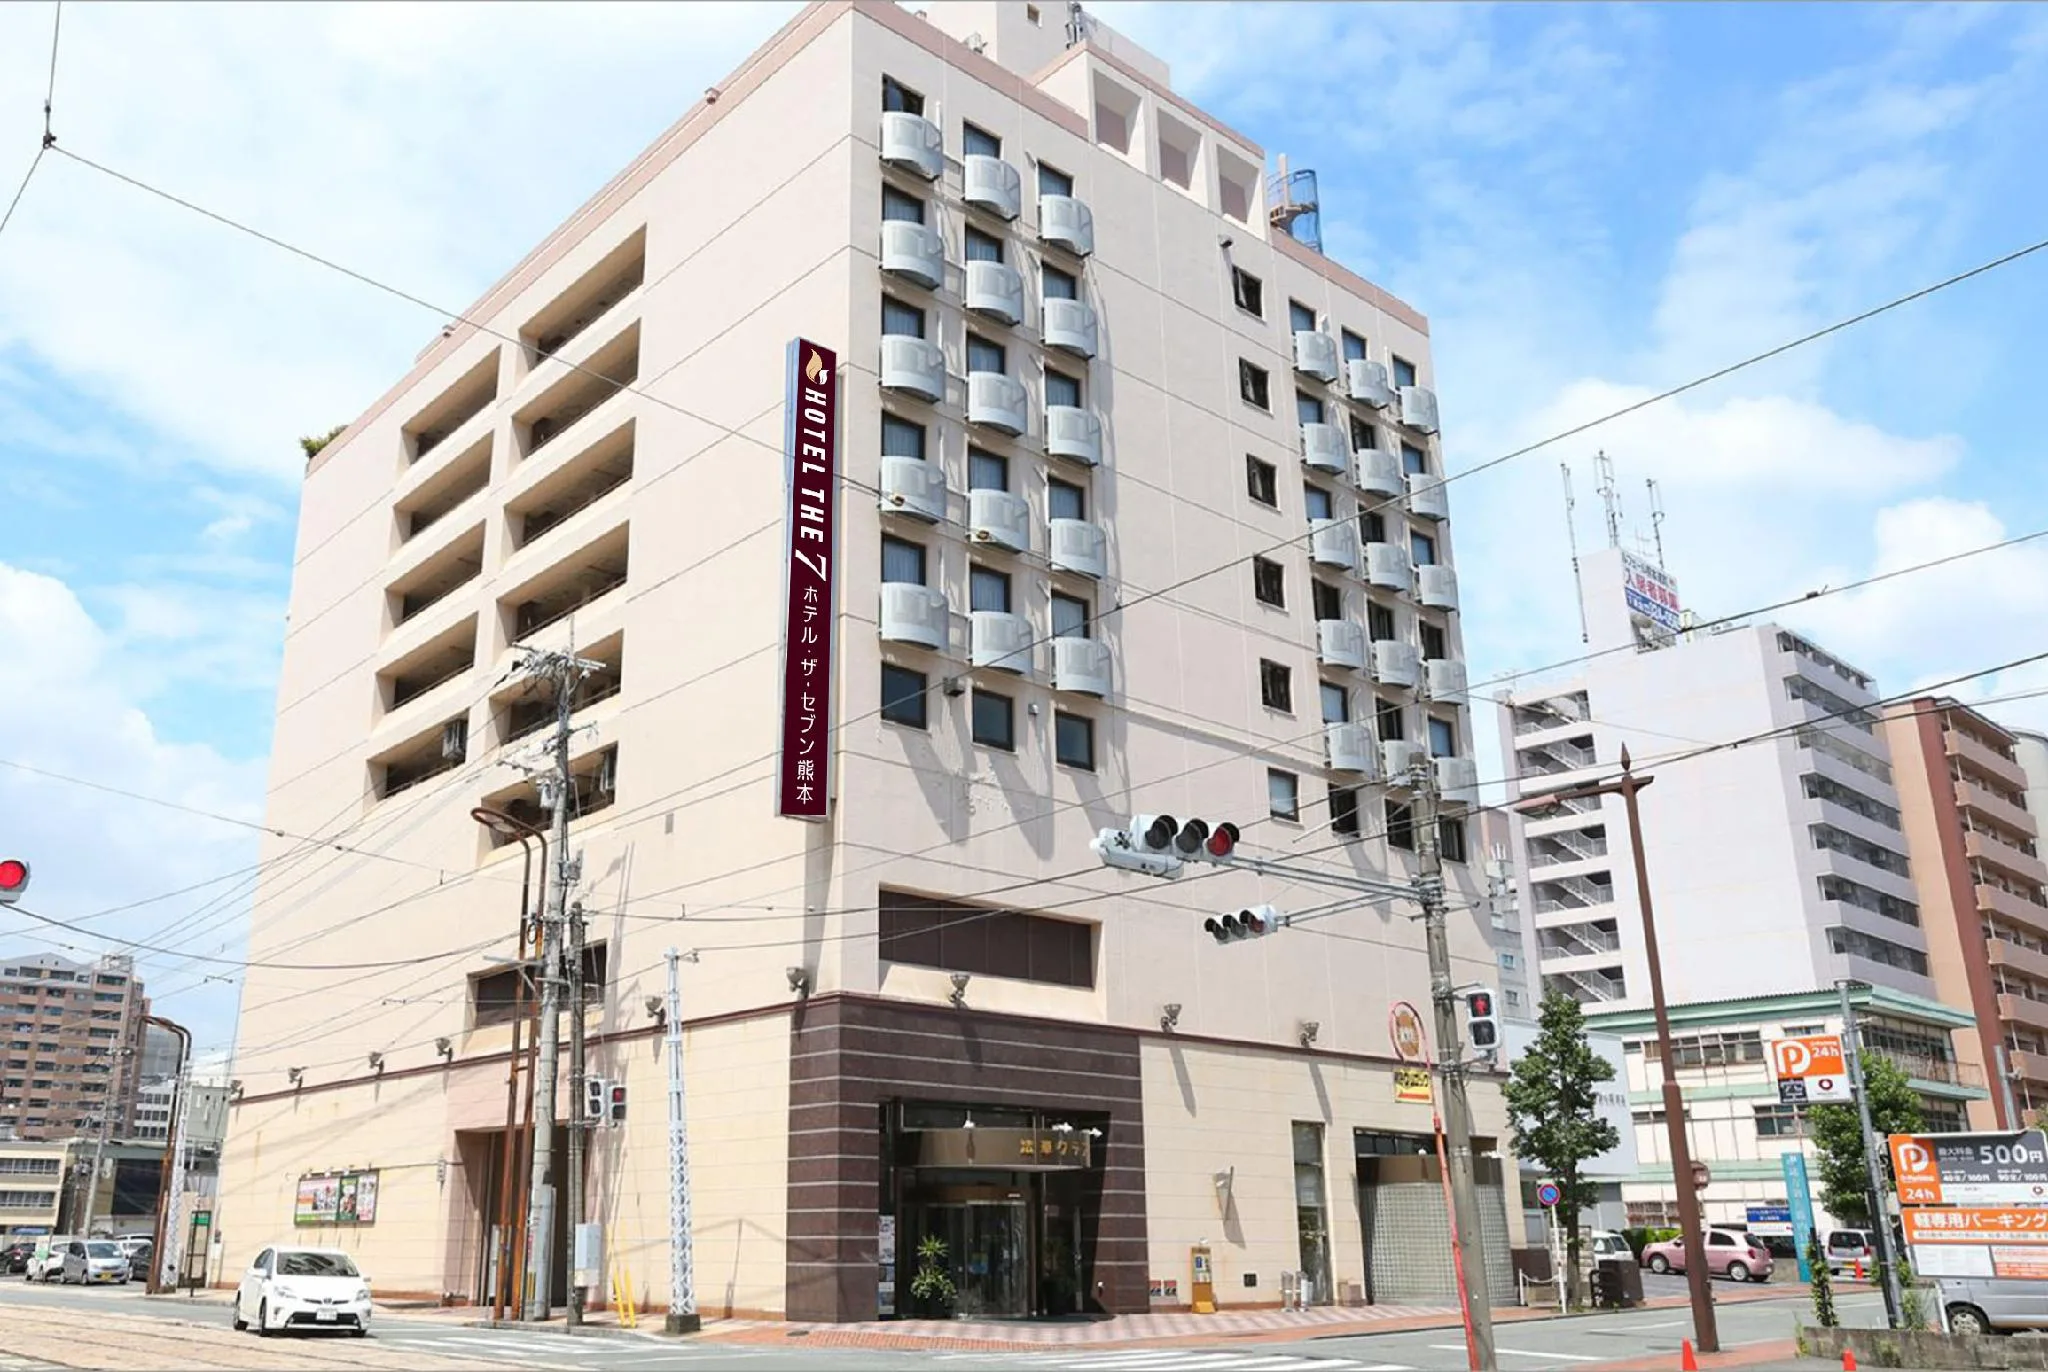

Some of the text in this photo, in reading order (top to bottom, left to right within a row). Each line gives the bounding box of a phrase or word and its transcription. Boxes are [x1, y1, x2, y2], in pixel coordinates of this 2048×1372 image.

[794, 387, 827, 581] HOTEL THE 7
[1776, 1040, 1811, 1075] P
[1812, 1045, 1840, 1058] 24h
[1898, 1143, 1930, 1173] P
[1980, 1143, 2045, 1165] 500円
[1905, 1187, 1936, 1200] 24h
